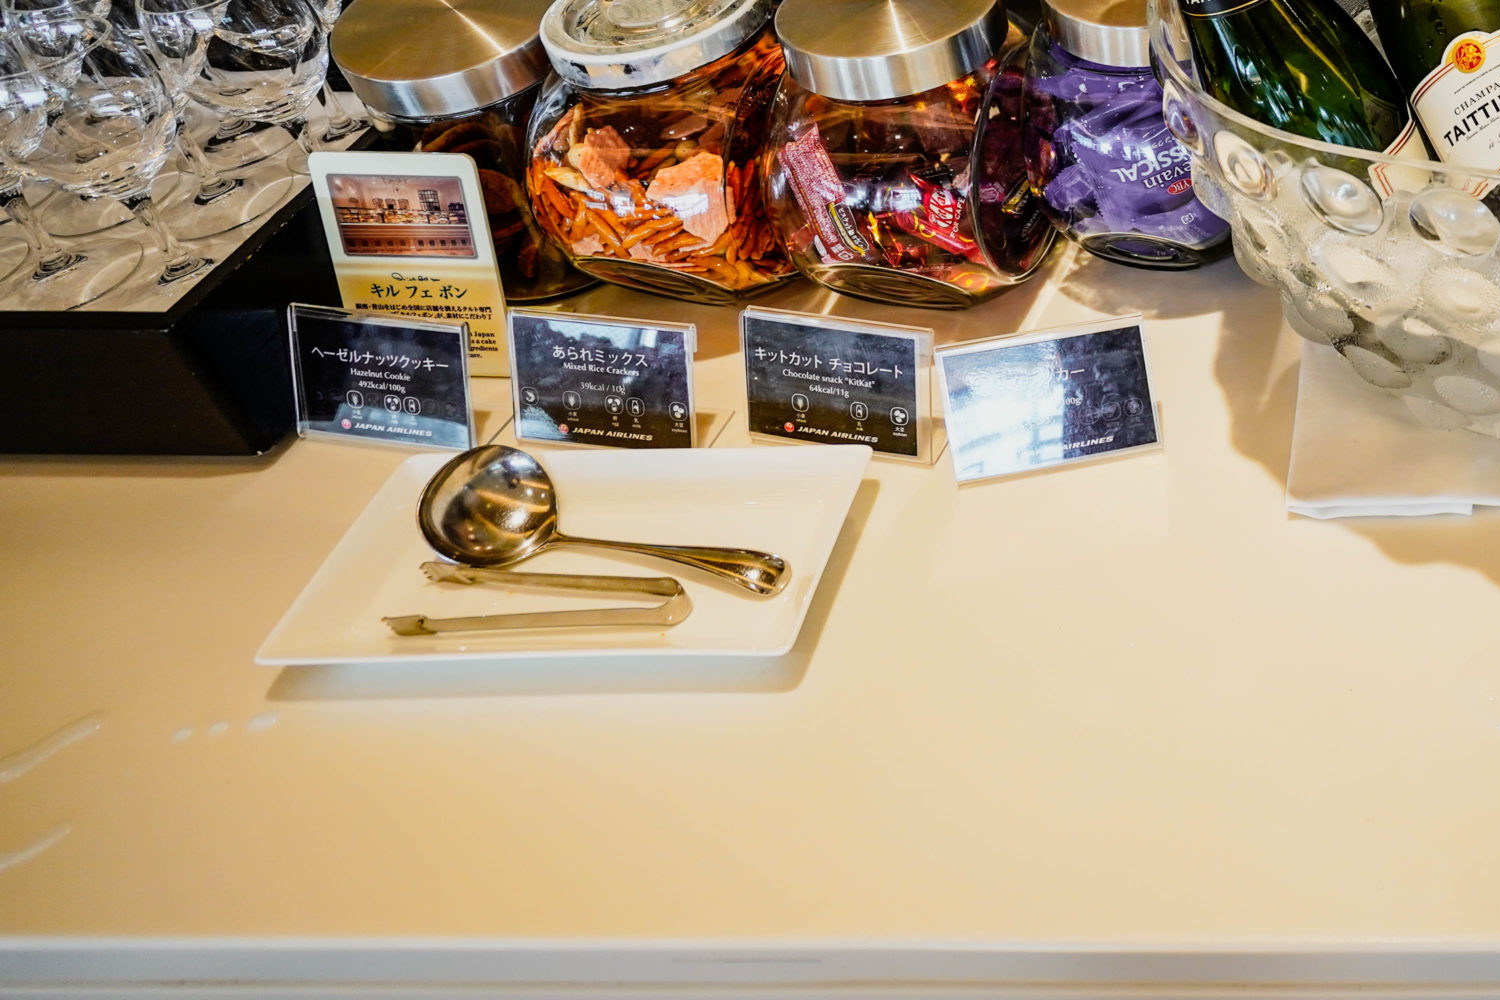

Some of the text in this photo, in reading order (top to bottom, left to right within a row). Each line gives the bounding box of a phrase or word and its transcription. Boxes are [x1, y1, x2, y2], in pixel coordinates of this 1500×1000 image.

[1110, 145, 1187, 183] SSICAL
[1143, 163, 1192, 190] evain
[371, 284, 467, 299] キル フェ ボン
[311, 346, 449, 372] ヘーゼルナッツクッキー
[552, 344, 648, 367] あられミックス
[754, 346, 904, 380] キットカット チョコレート
[350, 367, 411, 382] Hazelnut Cookie
[563, 361, 640, 377] Mixed Rice Crackers
[782, 368, 875, 388] Chocolate snack "KitKat"
[358, 380, 406, 394] 492kcal/100g
[580, 381, 605, 392] 39kcal
[809, 384, 850, 398] 64kcal/11g
[354, 422, 433, 437] JAPAN AIRLINES
[572, 427, 653, 441] JAPAN AIRLINES
[797, 425, 879, 443] JAPAN AIRLINES
[1062, 435, 1114, 451] AIRLINES
